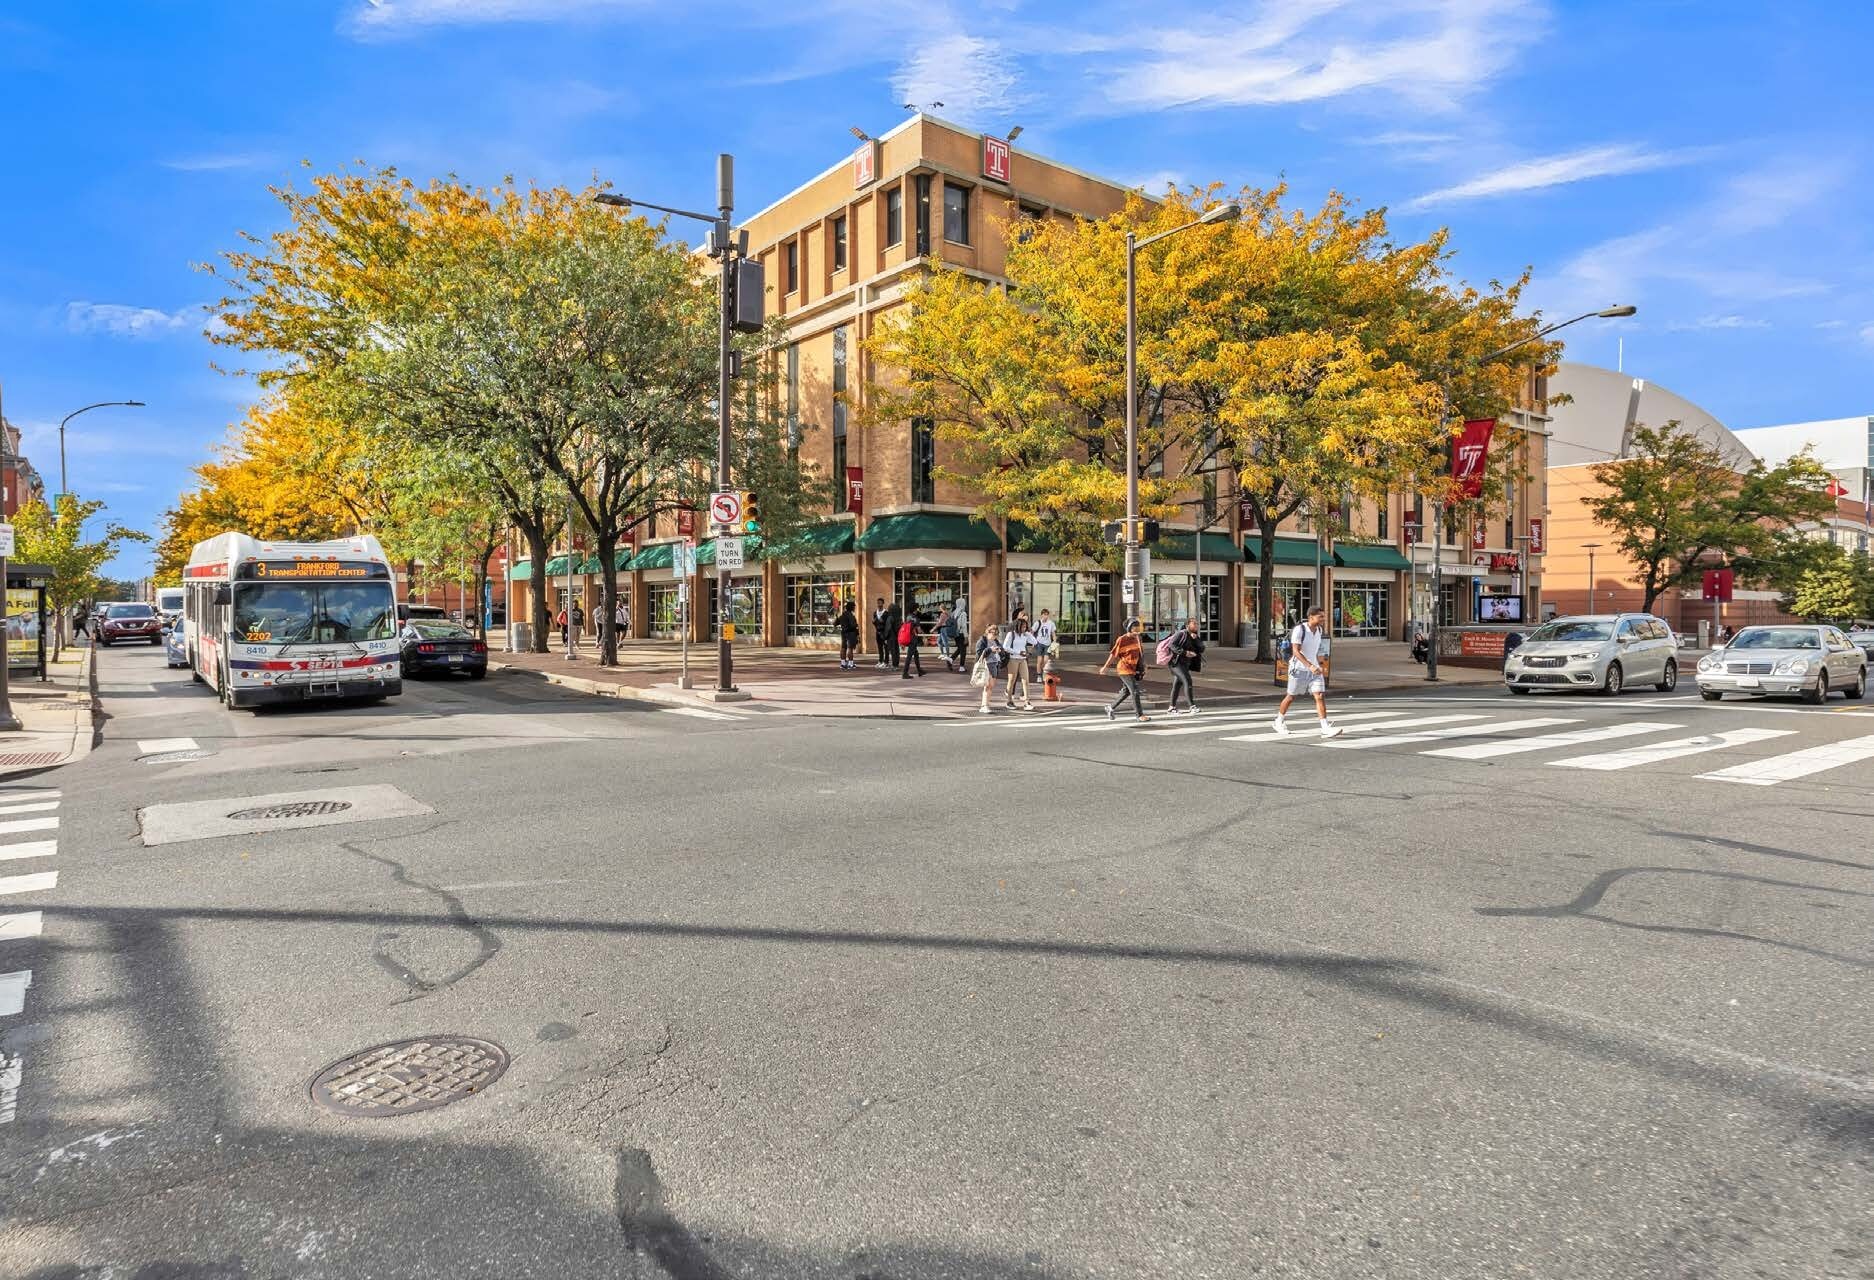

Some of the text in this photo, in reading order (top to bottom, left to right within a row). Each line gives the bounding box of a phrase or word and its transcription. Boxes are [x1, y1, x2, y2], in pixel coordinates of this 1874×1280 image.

[296, 562, 340, 570] FRANKFORD
[718, 558, 742, 566] ON RED
[257, 562, 267, 577] 3
[269, 569, 366, 577] TRANSPORTATION CENTER
[6, 600, 38, 609] A Fall
[246, 631, 272, 641] 2202
[246, 646, 267, 654] 8410
[307, 660, 344, 670] SEPTA
